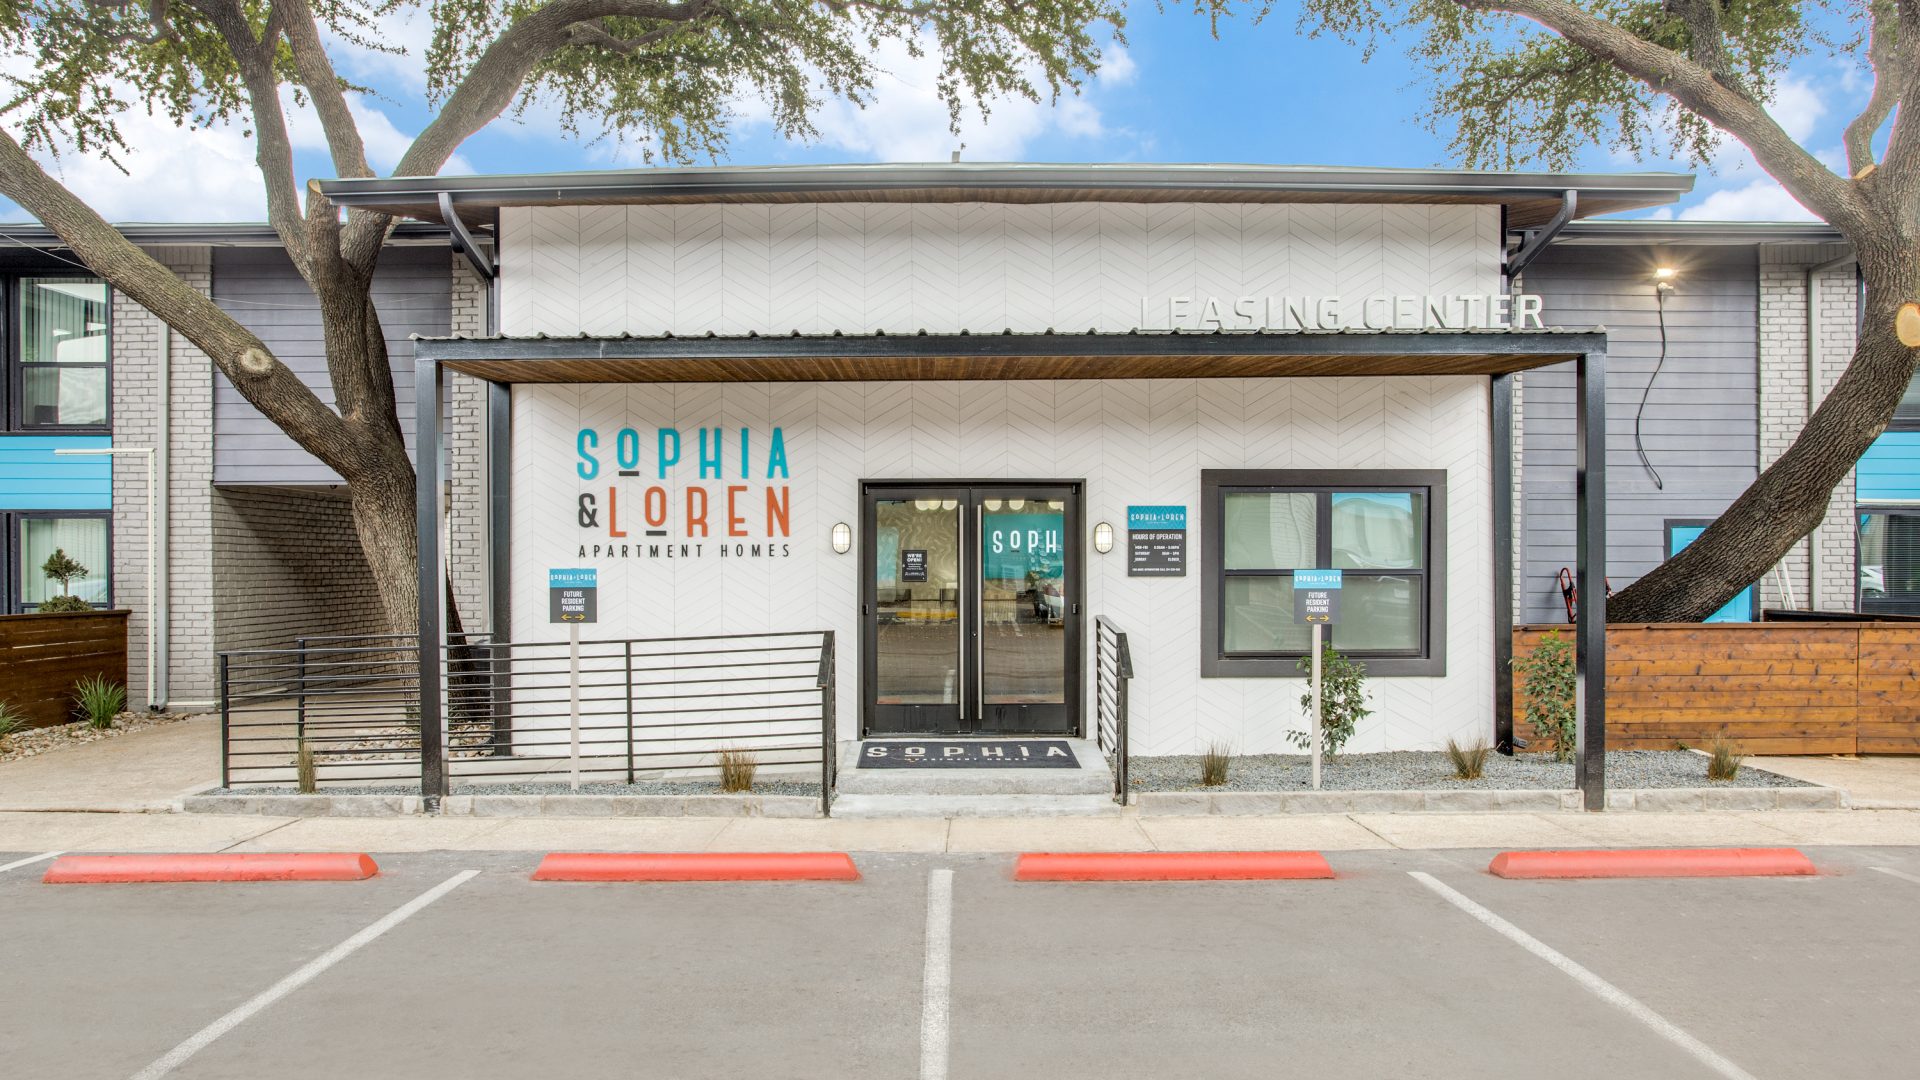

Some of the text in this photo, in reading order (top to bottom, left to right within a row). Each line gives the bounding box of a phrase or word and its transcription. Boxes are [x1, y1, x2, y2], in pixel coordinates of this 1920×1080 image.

[1141, 295, 1545, 330] LEASING CENTER
[576, 426, 790, 481] SOPHIA
[578, 485, 790, 538] & LOREN
[1130, 513, 1157, 521] SOPHIA
[1161, 513, 1185, 521] LOREN
[578, 544, 790, 558] APARTMENT HOMES
[563, 590, 583, 598] FUTURE
[1308, 591, 1328, 599] FUTURE
[561, 597, 585, 605] RESIDENT
[1305, 598, 1330, 606] RESIDENT
[866, 745, 1068, 758] SOPHIA
